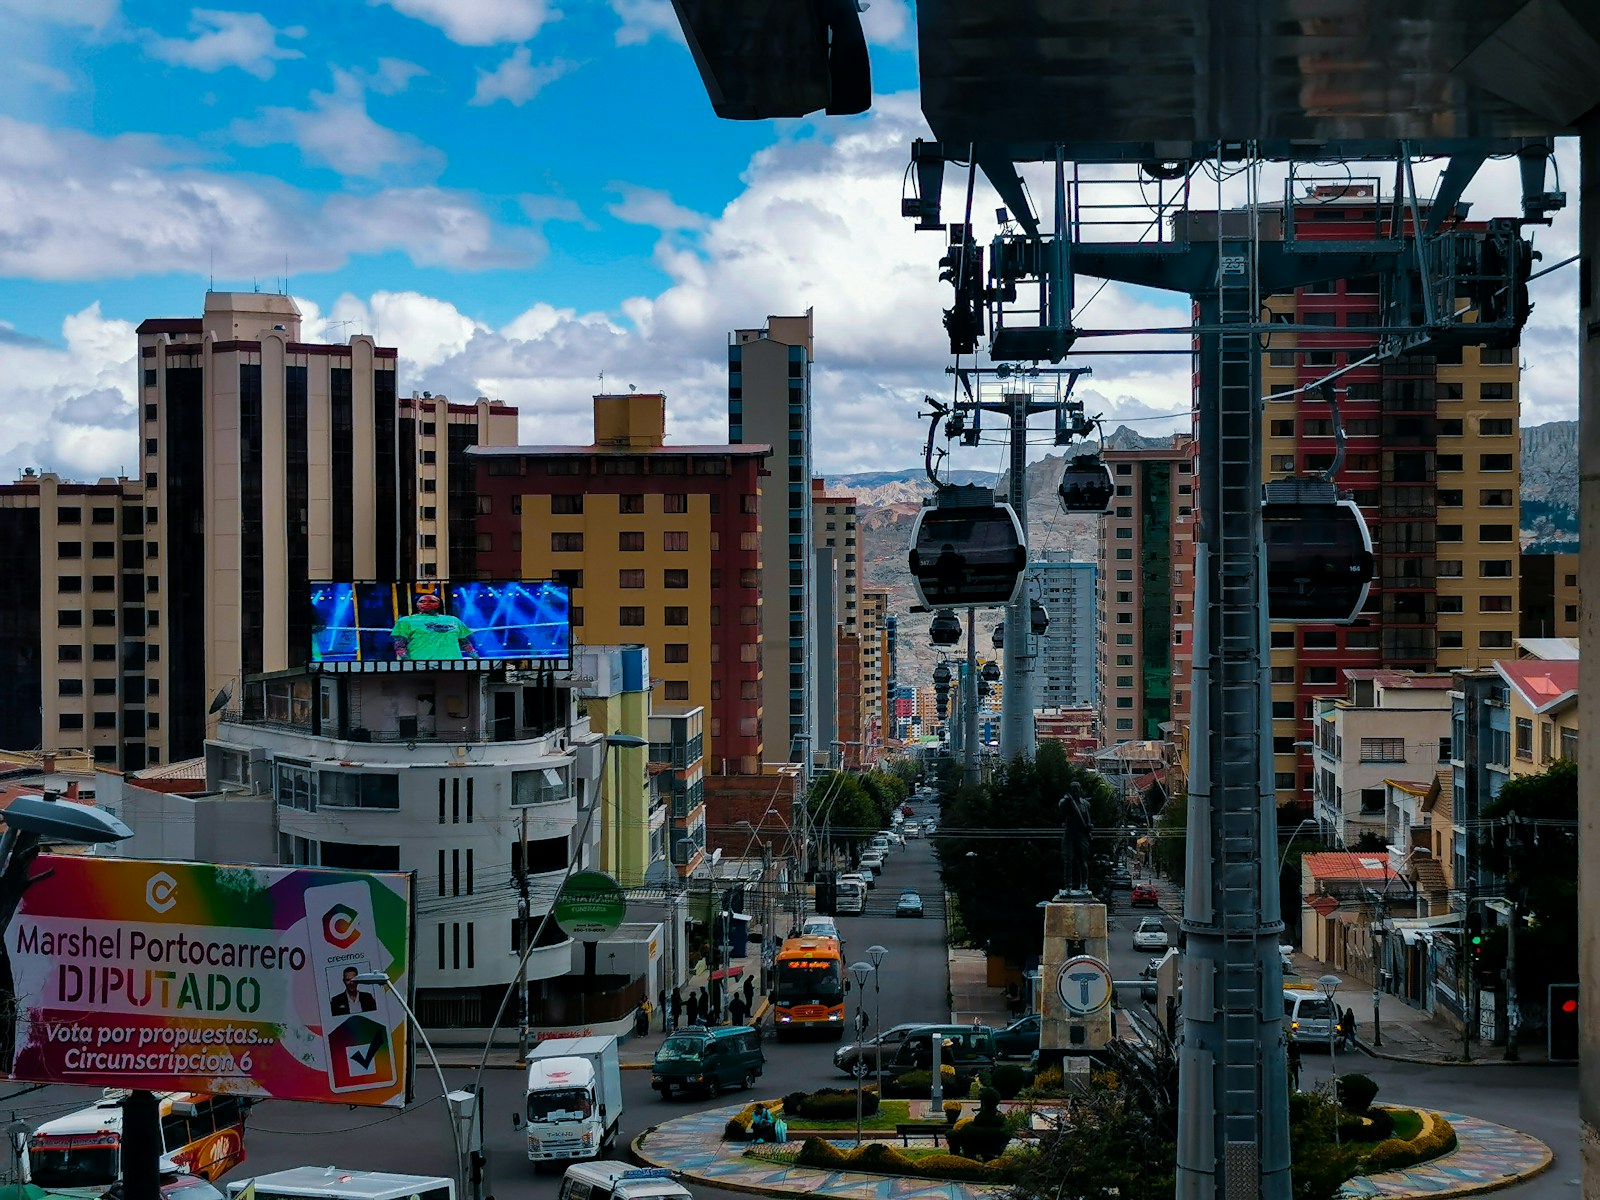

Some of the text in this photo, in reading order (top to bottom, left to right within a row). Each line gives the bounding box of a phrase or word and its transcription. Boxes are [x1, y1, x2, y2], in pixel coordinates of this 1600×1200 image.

[1225, 258, 1240, 268] 25
[16, 924, 306, 971] Marshel Portocarrero
[327, 952, 365, 963] creemos
[58, 964, 261, 1014] DIPUTADO
[45, 1022, 274, 1048] Vota por propuestas...
[64, 1045, 252, 1074] Circunscripcion 6
